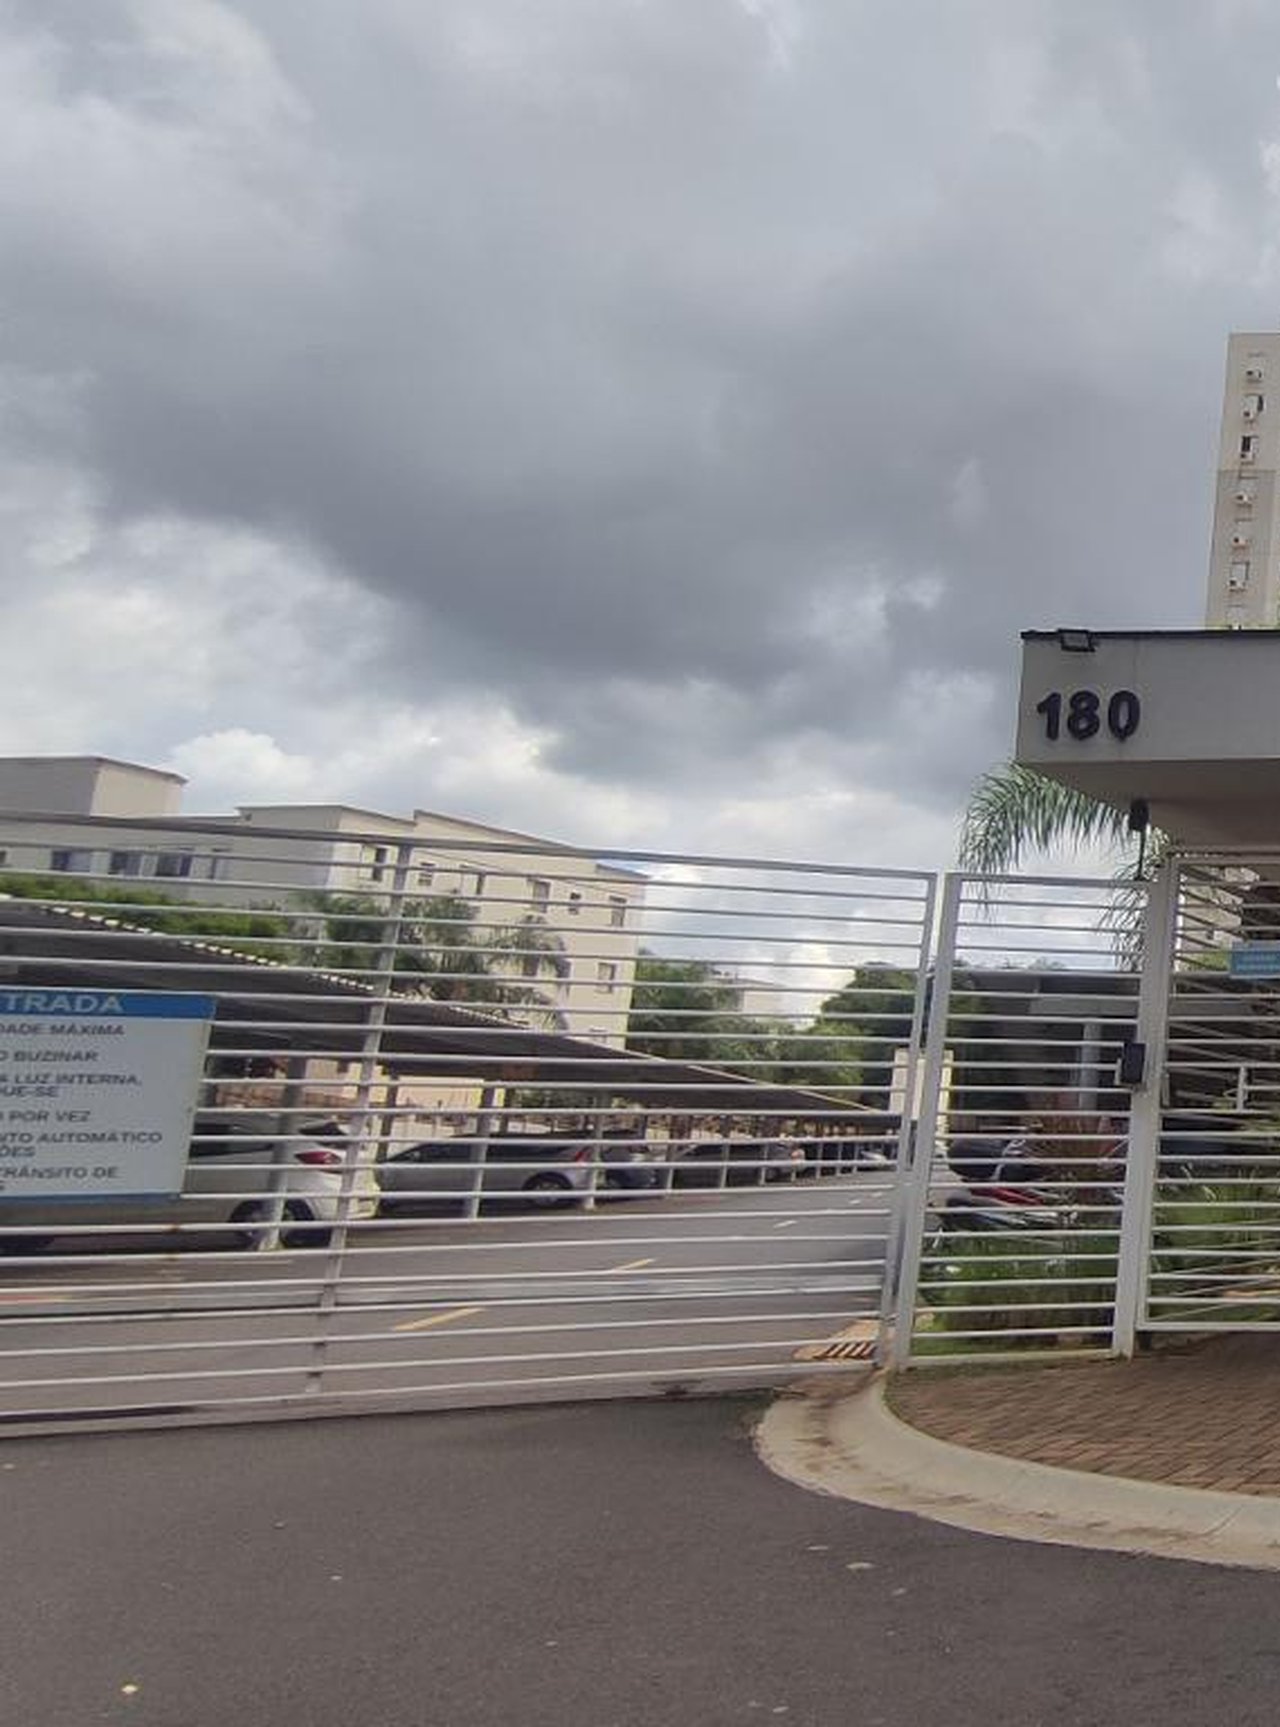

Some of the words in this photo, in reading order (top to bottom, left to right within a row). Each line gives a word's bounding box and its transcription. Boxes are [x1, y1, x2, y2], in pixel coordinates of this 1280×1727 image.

[1037, 690, 1141, 741] 180
[13, 1049, 99, 1063] BUZINAR
[0, 1085, 60, 1098] UE-SE
[9, 1110, 50, 1122] POR
[56, 1110, 91, 1123] VEZ
[92, 1166, 121, 1179] DE
